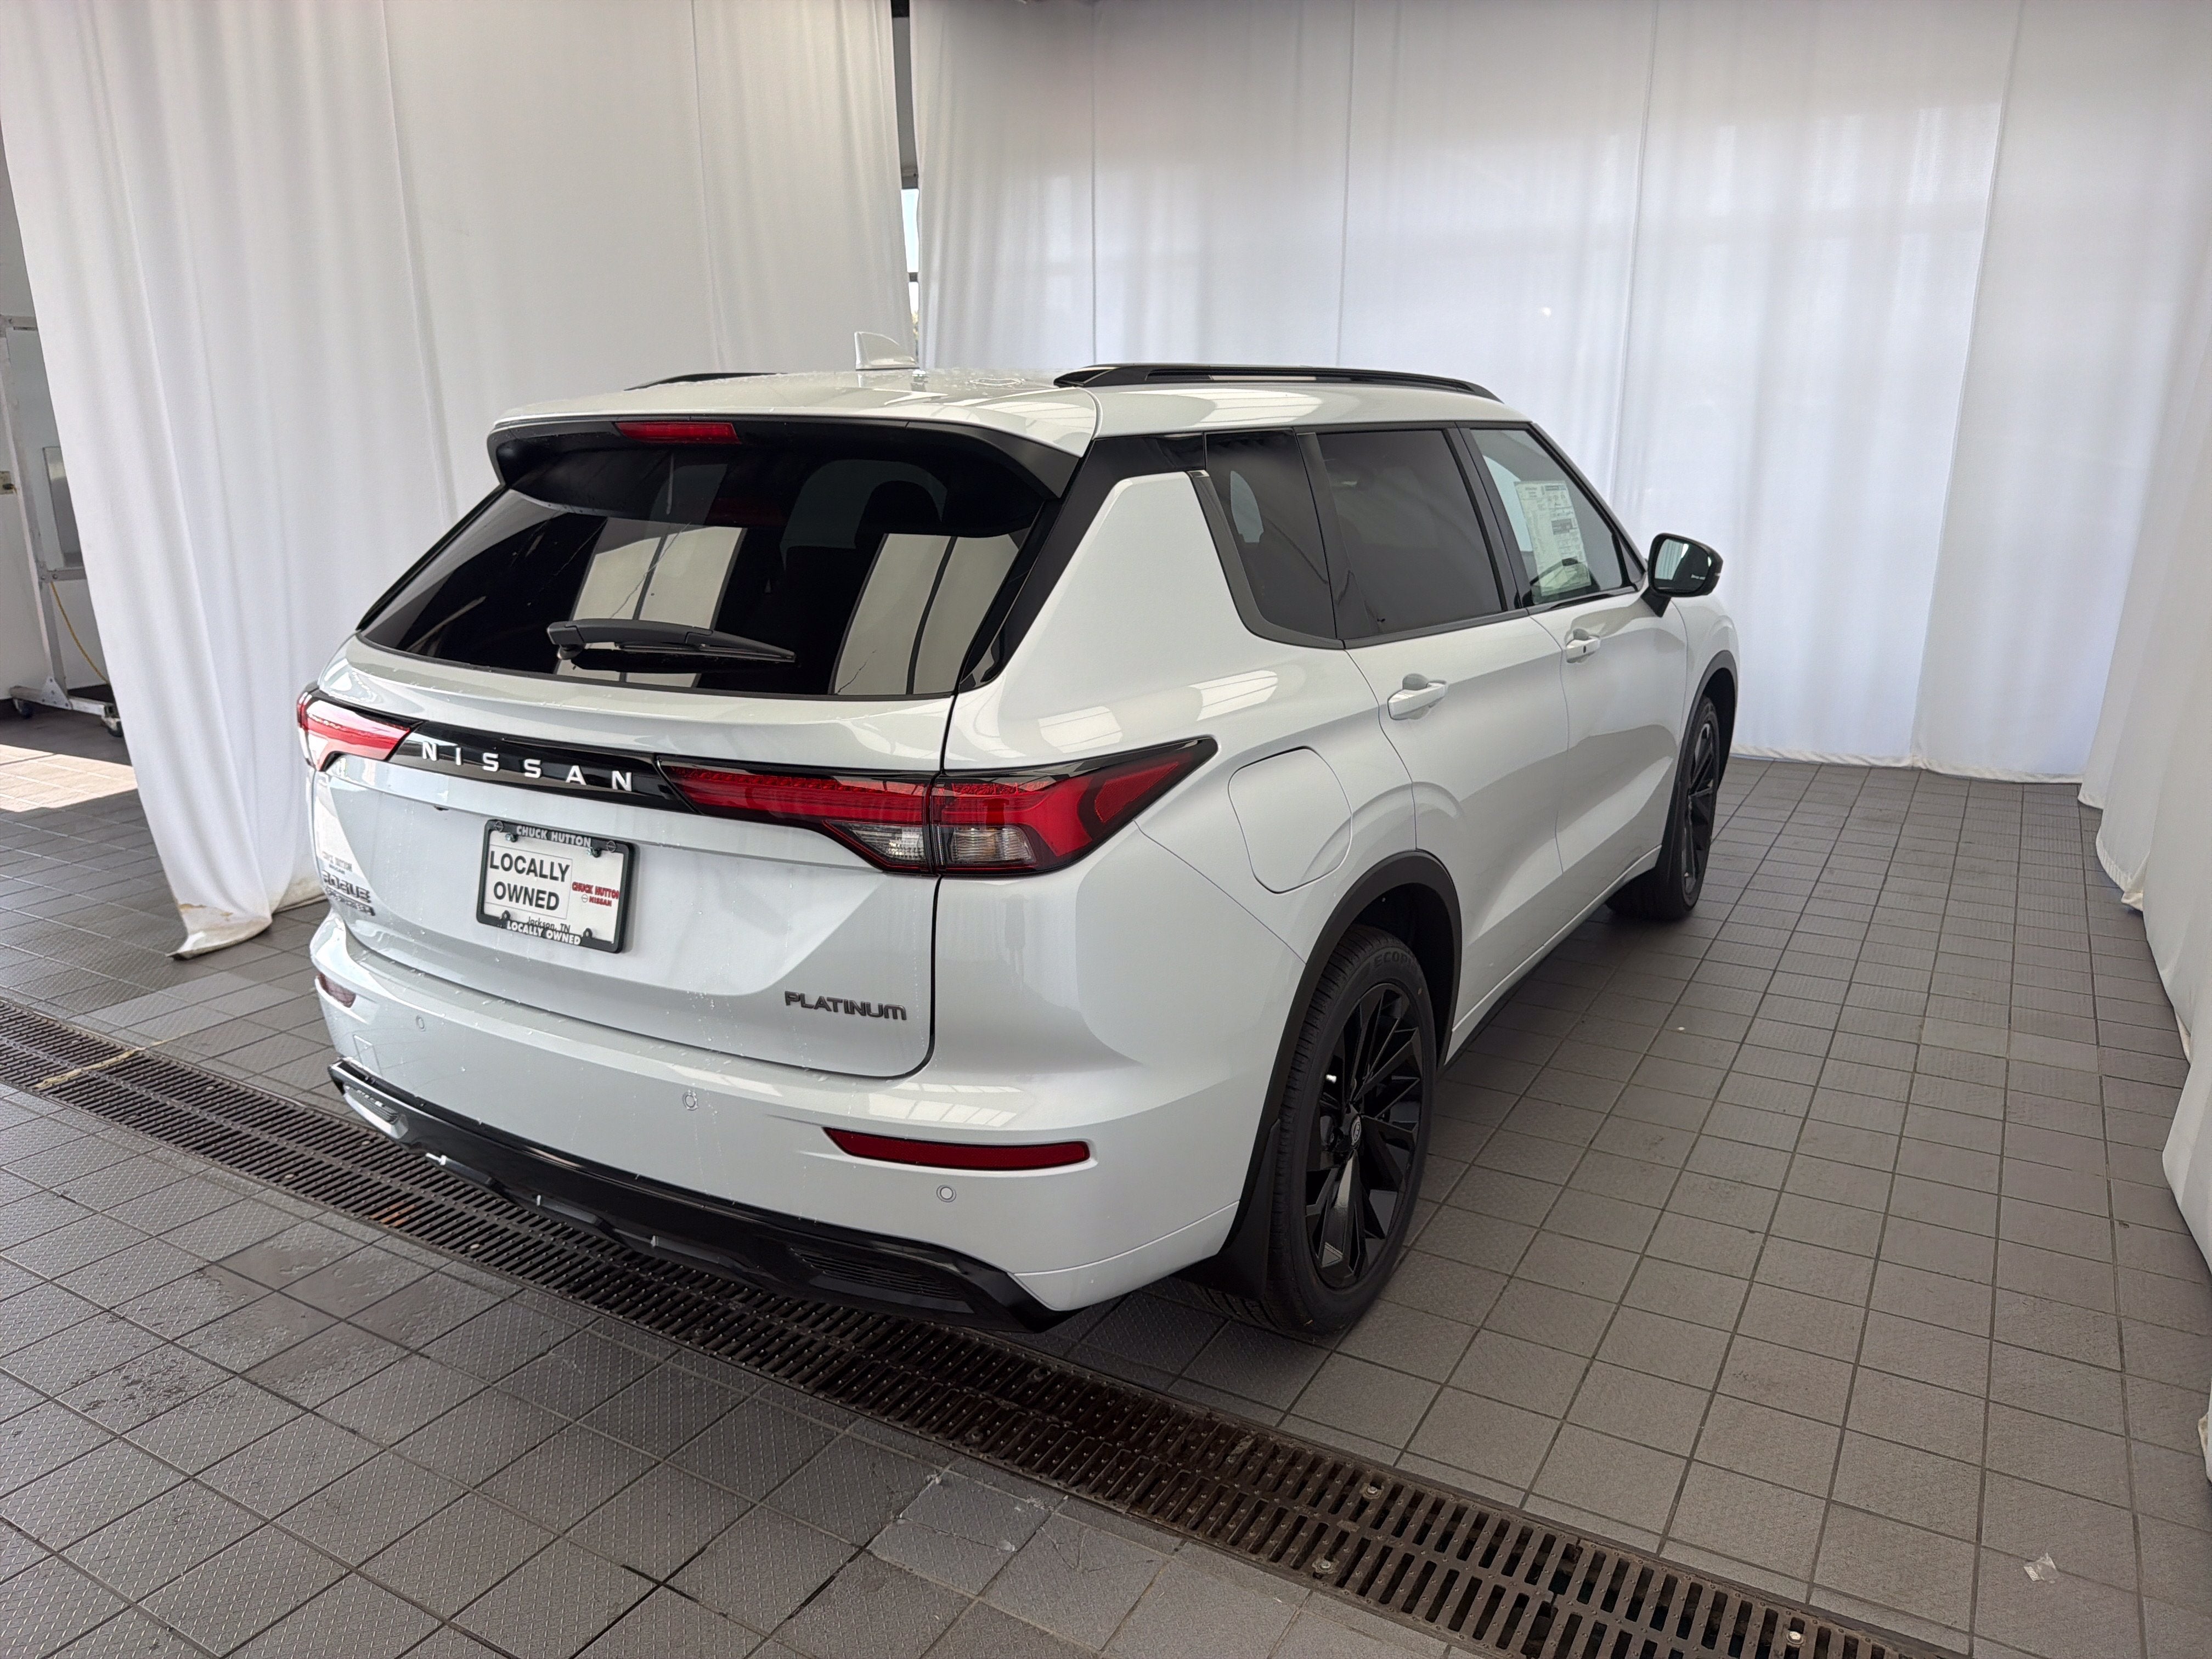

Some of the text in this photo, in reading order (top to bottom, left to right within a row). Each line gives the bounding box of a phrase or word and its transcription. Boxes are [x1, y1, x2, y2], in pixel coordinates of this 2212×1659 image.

[421, 741, 633, 792] NISSAN
[516, 825, 591, 848] CHUCK HUTTON
[489, 850, 571, 883] LOCALLY
[493, 881, 560, 911] OWNED
[572, 882, 594, 894] CHUCK
[589, 896, 612, 907] NISSAN
[506, 921, 581, 945] LOCALLY OWNED
[560, 923, 571, 933] TN
[785, 990, 907, 1021] PLATINUM
